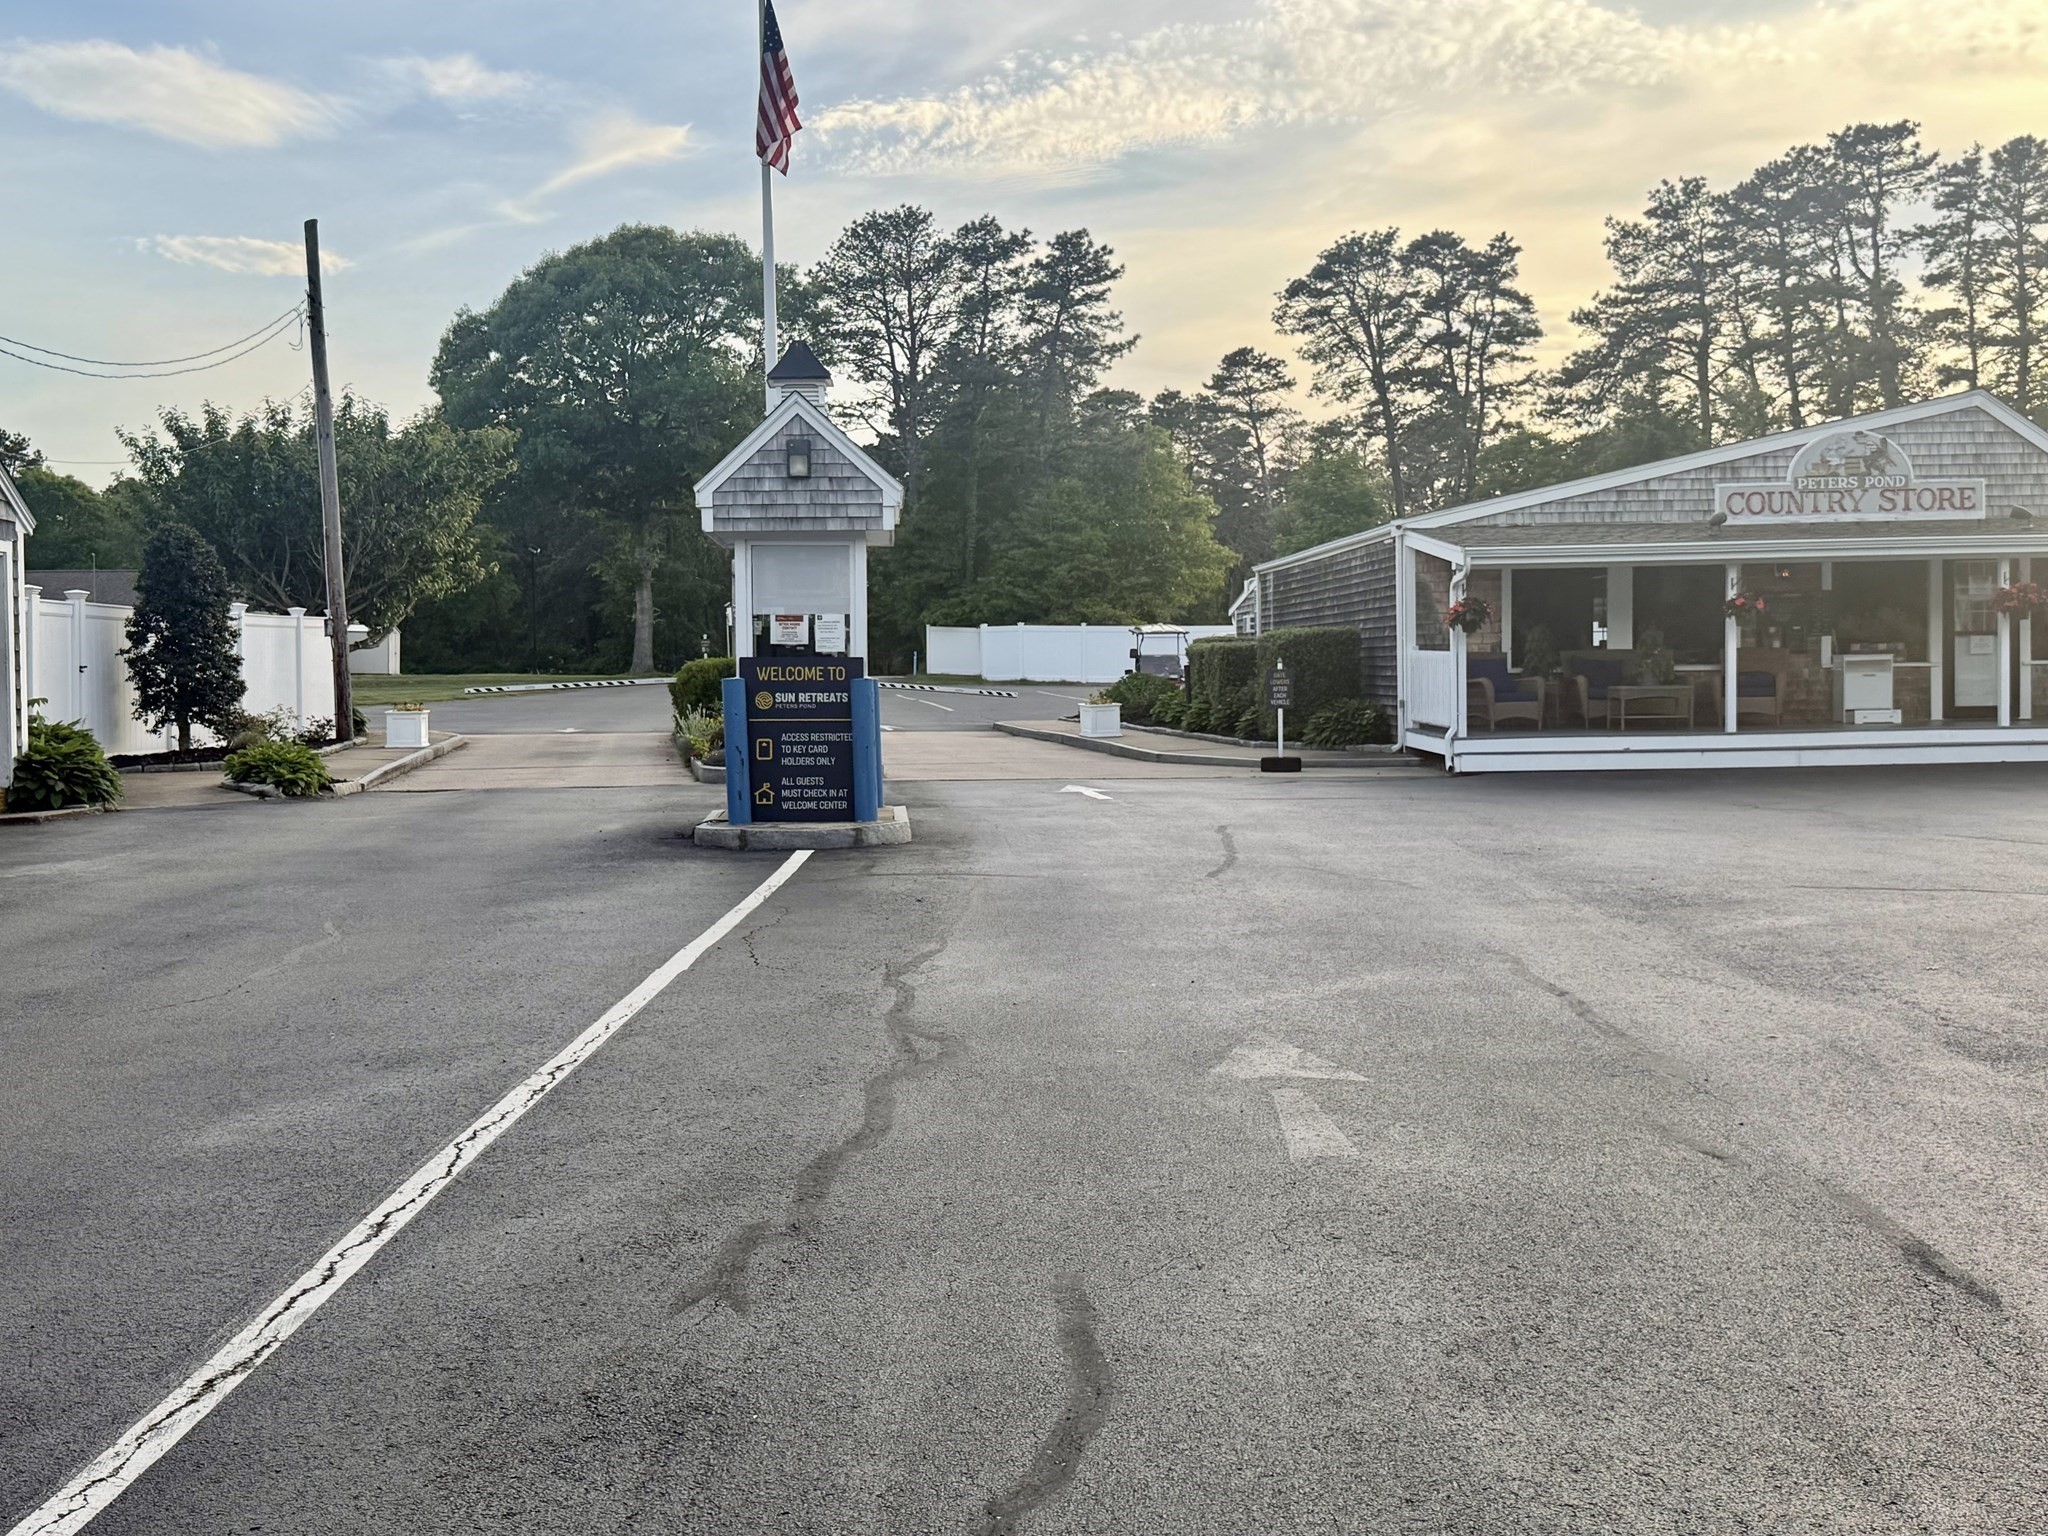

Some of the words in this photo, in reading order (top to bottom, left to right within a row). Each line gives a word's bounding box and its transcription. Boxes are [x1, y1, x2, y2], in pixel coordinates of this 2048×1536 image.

[1797, 476, 1859, 490] PETERS
[1864, 475, 1906, 488] POND
[1726, 488, 1869, 516] COUNTRY
[1877, 486, 1977, 513] STORE
[757, 667, 823, 680] WELCOME
[828, 667, 845, 680] TO
[775, 692, 796, 703] SUN
[799, 692, 849, 703] RETREATS
[781, 733, 810, 742] ACCESS
[781, 745, 792, 753] TO
[793, 745, 806, 753] KEY
[808, 745, 828, 753] CARD
[781, 757, 815, 766] HOLDERS
[816, 757, 836, 766] ONLY
[781, 777, 795, 786] ALL
[796, 777, 824, 786] GUESTS
[781, 789, 802, 798] MUST
[803, 789, 828, 798] CHECK
[829, 789, 837, 798] IN
[838, 789, 848, 798] AT
[781, 801, 818, 810] WELCOME
[819, 801, 848, 810] CENTER
